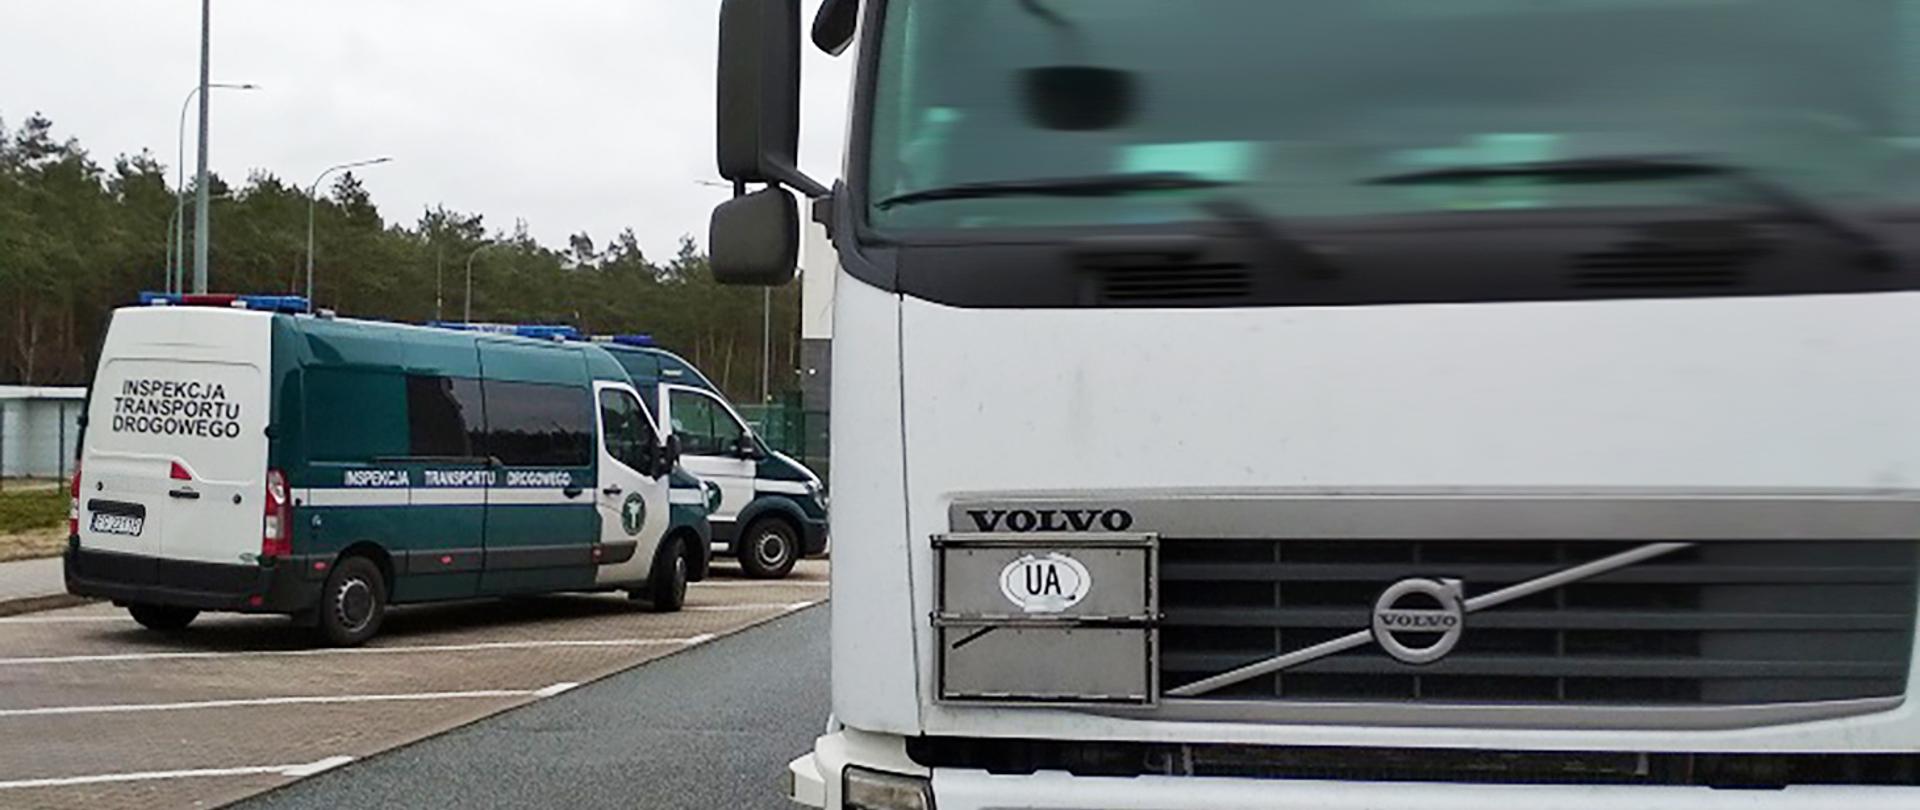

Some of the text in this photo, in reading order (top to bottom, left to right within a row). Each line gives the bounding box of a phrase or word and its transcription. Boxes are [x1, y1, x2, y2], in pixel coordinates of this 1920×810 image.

[122, 379, 226, 400] INSPEKCJA
[113, 397, 240, 420] TRANSPORTU
[112, 415, 241, 438] DROGOWEGO
[424, 470, 495, 486] TRANSPORTU
[966, 508, 1133, 532] VOLVO
[1026, 564, 1062, 595] UA
[1378, 614, 1457, 627] VOLVO
